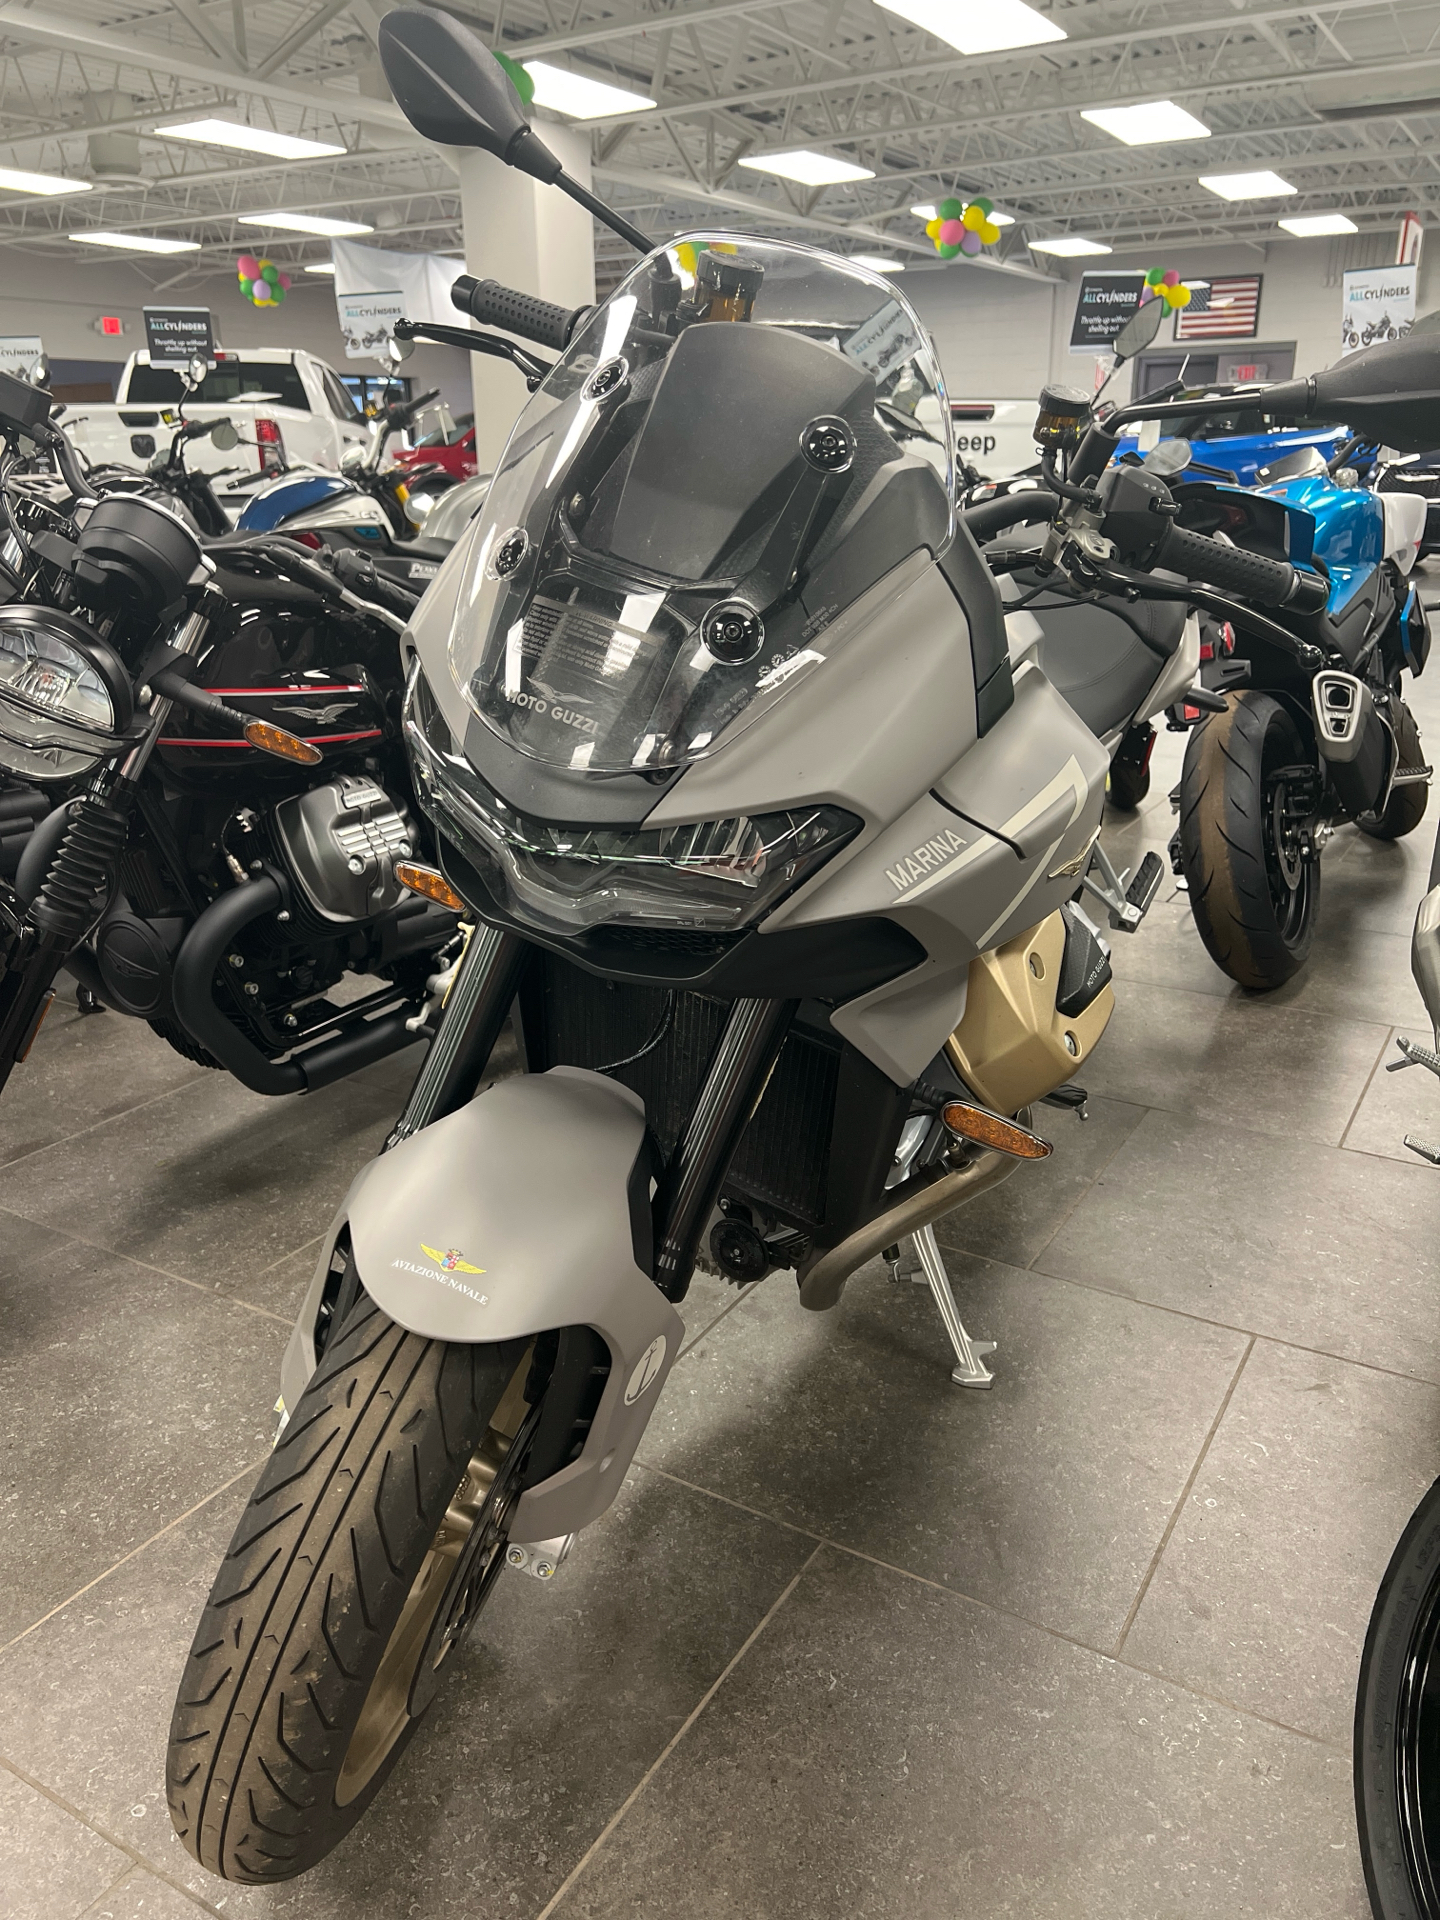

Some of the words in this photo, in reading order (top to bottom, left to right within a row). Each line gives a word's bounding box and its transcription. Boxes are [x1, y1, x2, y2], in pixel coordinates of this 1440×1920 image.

[953, 432, 996, 455] eep
[506, 689, 547, 713] MOTO
[551, 706, 600, 735] GUZZI
[886, 829, 967, 891] MARINA
[391, 1259, 449, 1284] AVIAZIONE
[447, 1279, 489, 1306] NAVALE
